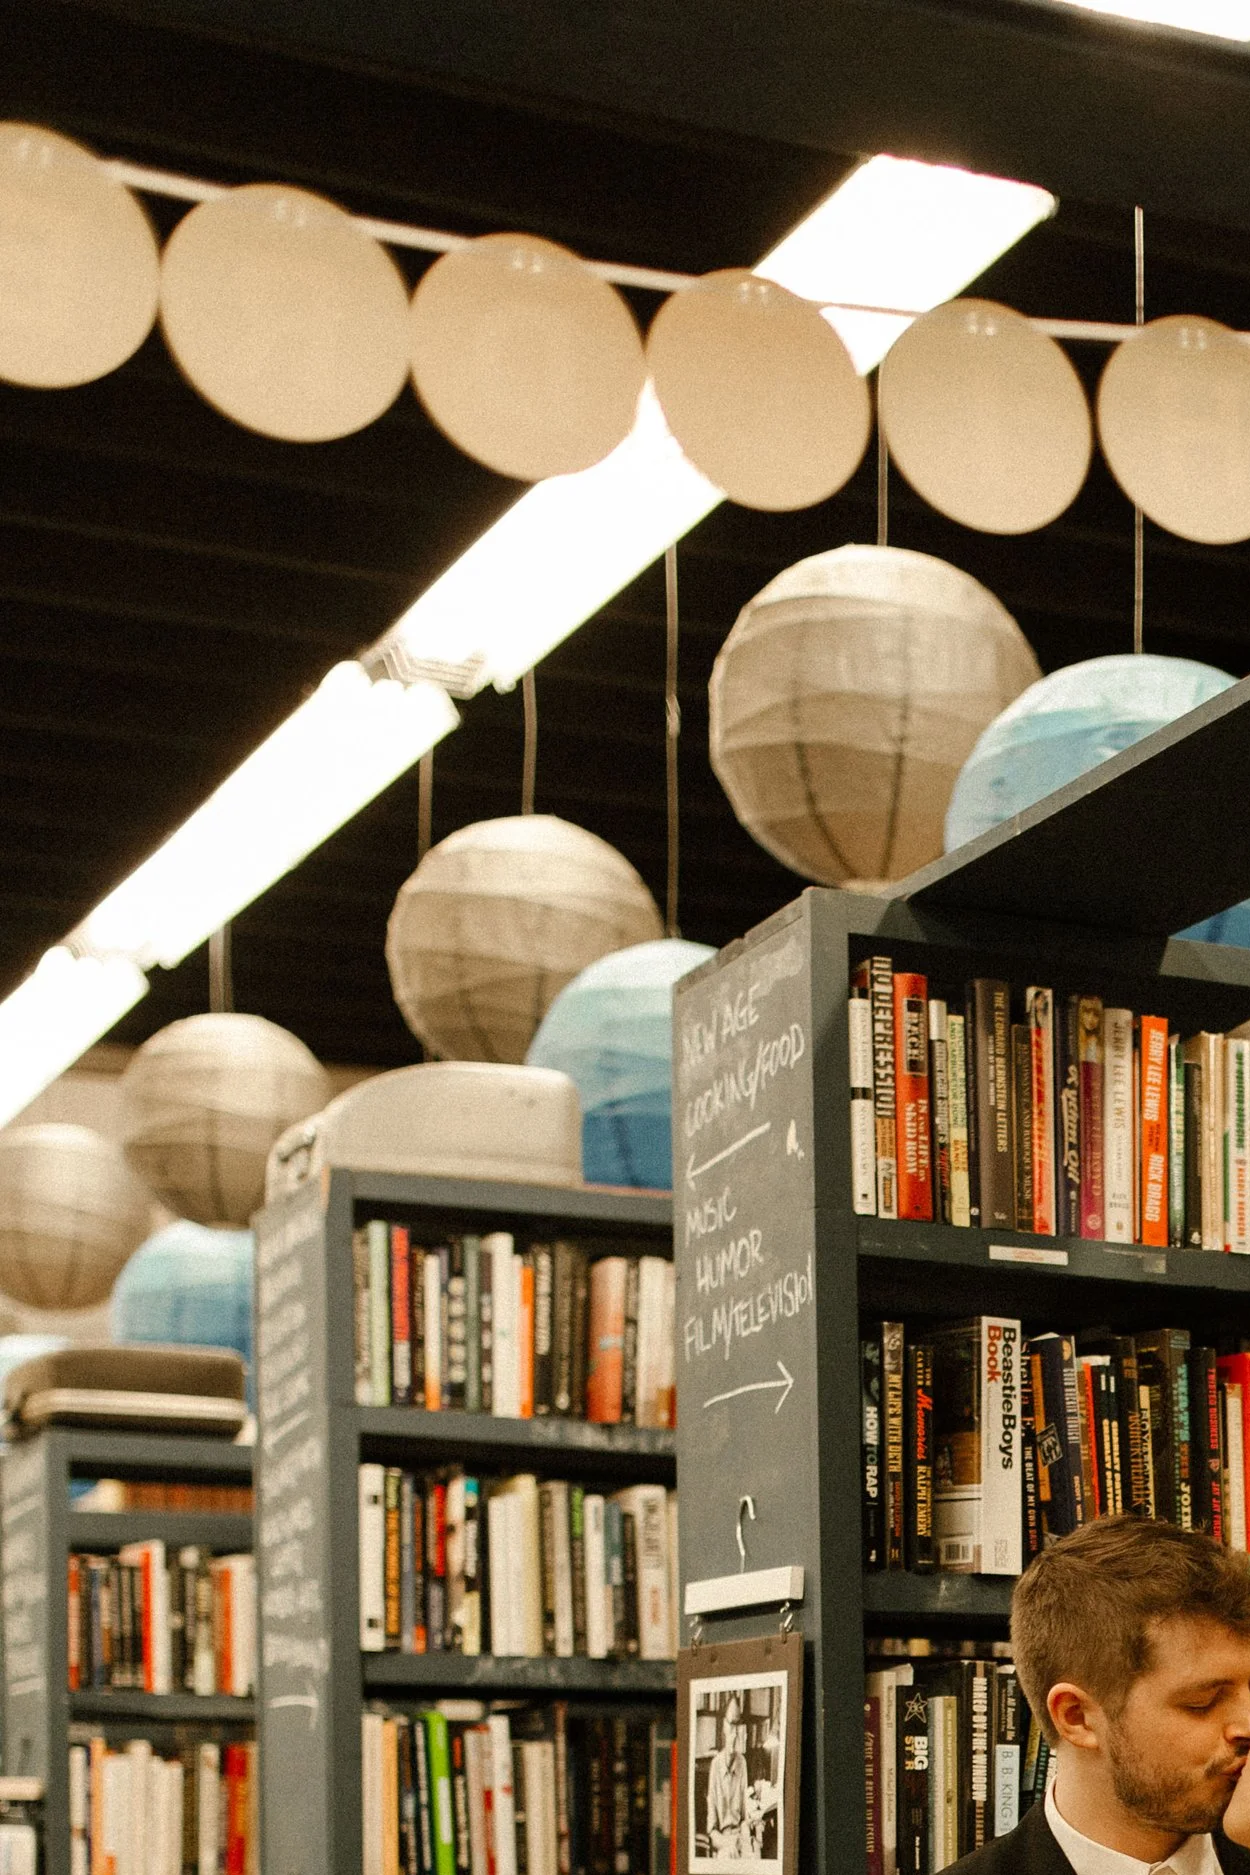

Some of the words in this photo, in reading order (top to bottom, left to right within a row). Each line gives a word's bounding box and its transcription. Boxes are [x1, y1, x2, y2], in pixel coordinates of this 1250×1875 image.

[994, 992, 1005, 1010] THE
[682, 1007, 718, 1070] NEW
[721, 983, 760, 1043] AGE
[994, 1011, 1006, 1054] LEONARD
[1113, 1022, 1127, 1059] JERRY
[1148, 1030, 1165, 1063] JERRY
[995, 1057, 1007, 1109] BERNSTEIN
[1113, 1064, 1126, 1085] LEE
[1146, 1065, 1164, 1084] LEE
[904, 1102, 916, 1139] SKID
[1113, 1091, 1127, 1130] LEWIS
[1143, 1086, 1164, 1121] LEWIS
[996, 1112, 1008, 1152] LETTERS
[905, 1141, 917, 1174] ROW
[1147, 1154, 1165, 1180] RICK
[685, 1185, 738, 1249] MUSIC
[1145, 1183, 1164, 1221] BRAGG
[696, 1228, 765, 1297] HUMOR
[916, 1351, 924, 1386] CARTER
[986, 1325, 1001, 1383] Book
[888, 1374, 901, 1390] MY
[1207, 1368, 1217, 1405] TWISTED
[888, 1391, 901, 1416] LIFE
[865, 1406, 878, 1444] HOW
[888, 1418, 902, 1443] WITH
[915, 1388, 933, 1460] Memories
[1208, 1408, 1219, 1450] BUSINESS
[888, 1445, 902, 1472] DETH
[1023, 1446, 1033, 1460] THE
[866, 1464, 878, 1498] RAP
[916, 1465, 927, 1500] RALPH
[1024, 1462, 1034, 1481] BEAT
[1025, 1483, 1035, 1493] OF
[1025, 1495, 1035, 1507] MY
[1026, 1509, 1036, 1527] OWN
[916, 1503, 927, 1536] EMERY
[1028, 1529, 1038, 1551] DRUM
[972, 1677, 987, 1712] NAKED
[972, 1714, 987, 1730] BY
[904, 1736, 914, 1770] STR
[914, 1736, 928, 1771] BIG
[972, 1732, 987, 1751] THE
[1000, 1750, 1013, 1760] B.
[972, 1754, 987, 1801] WINDOW
[1000, 1767, 1013, 1780] B.
[1000, 1783, 1013, 1818] KING
